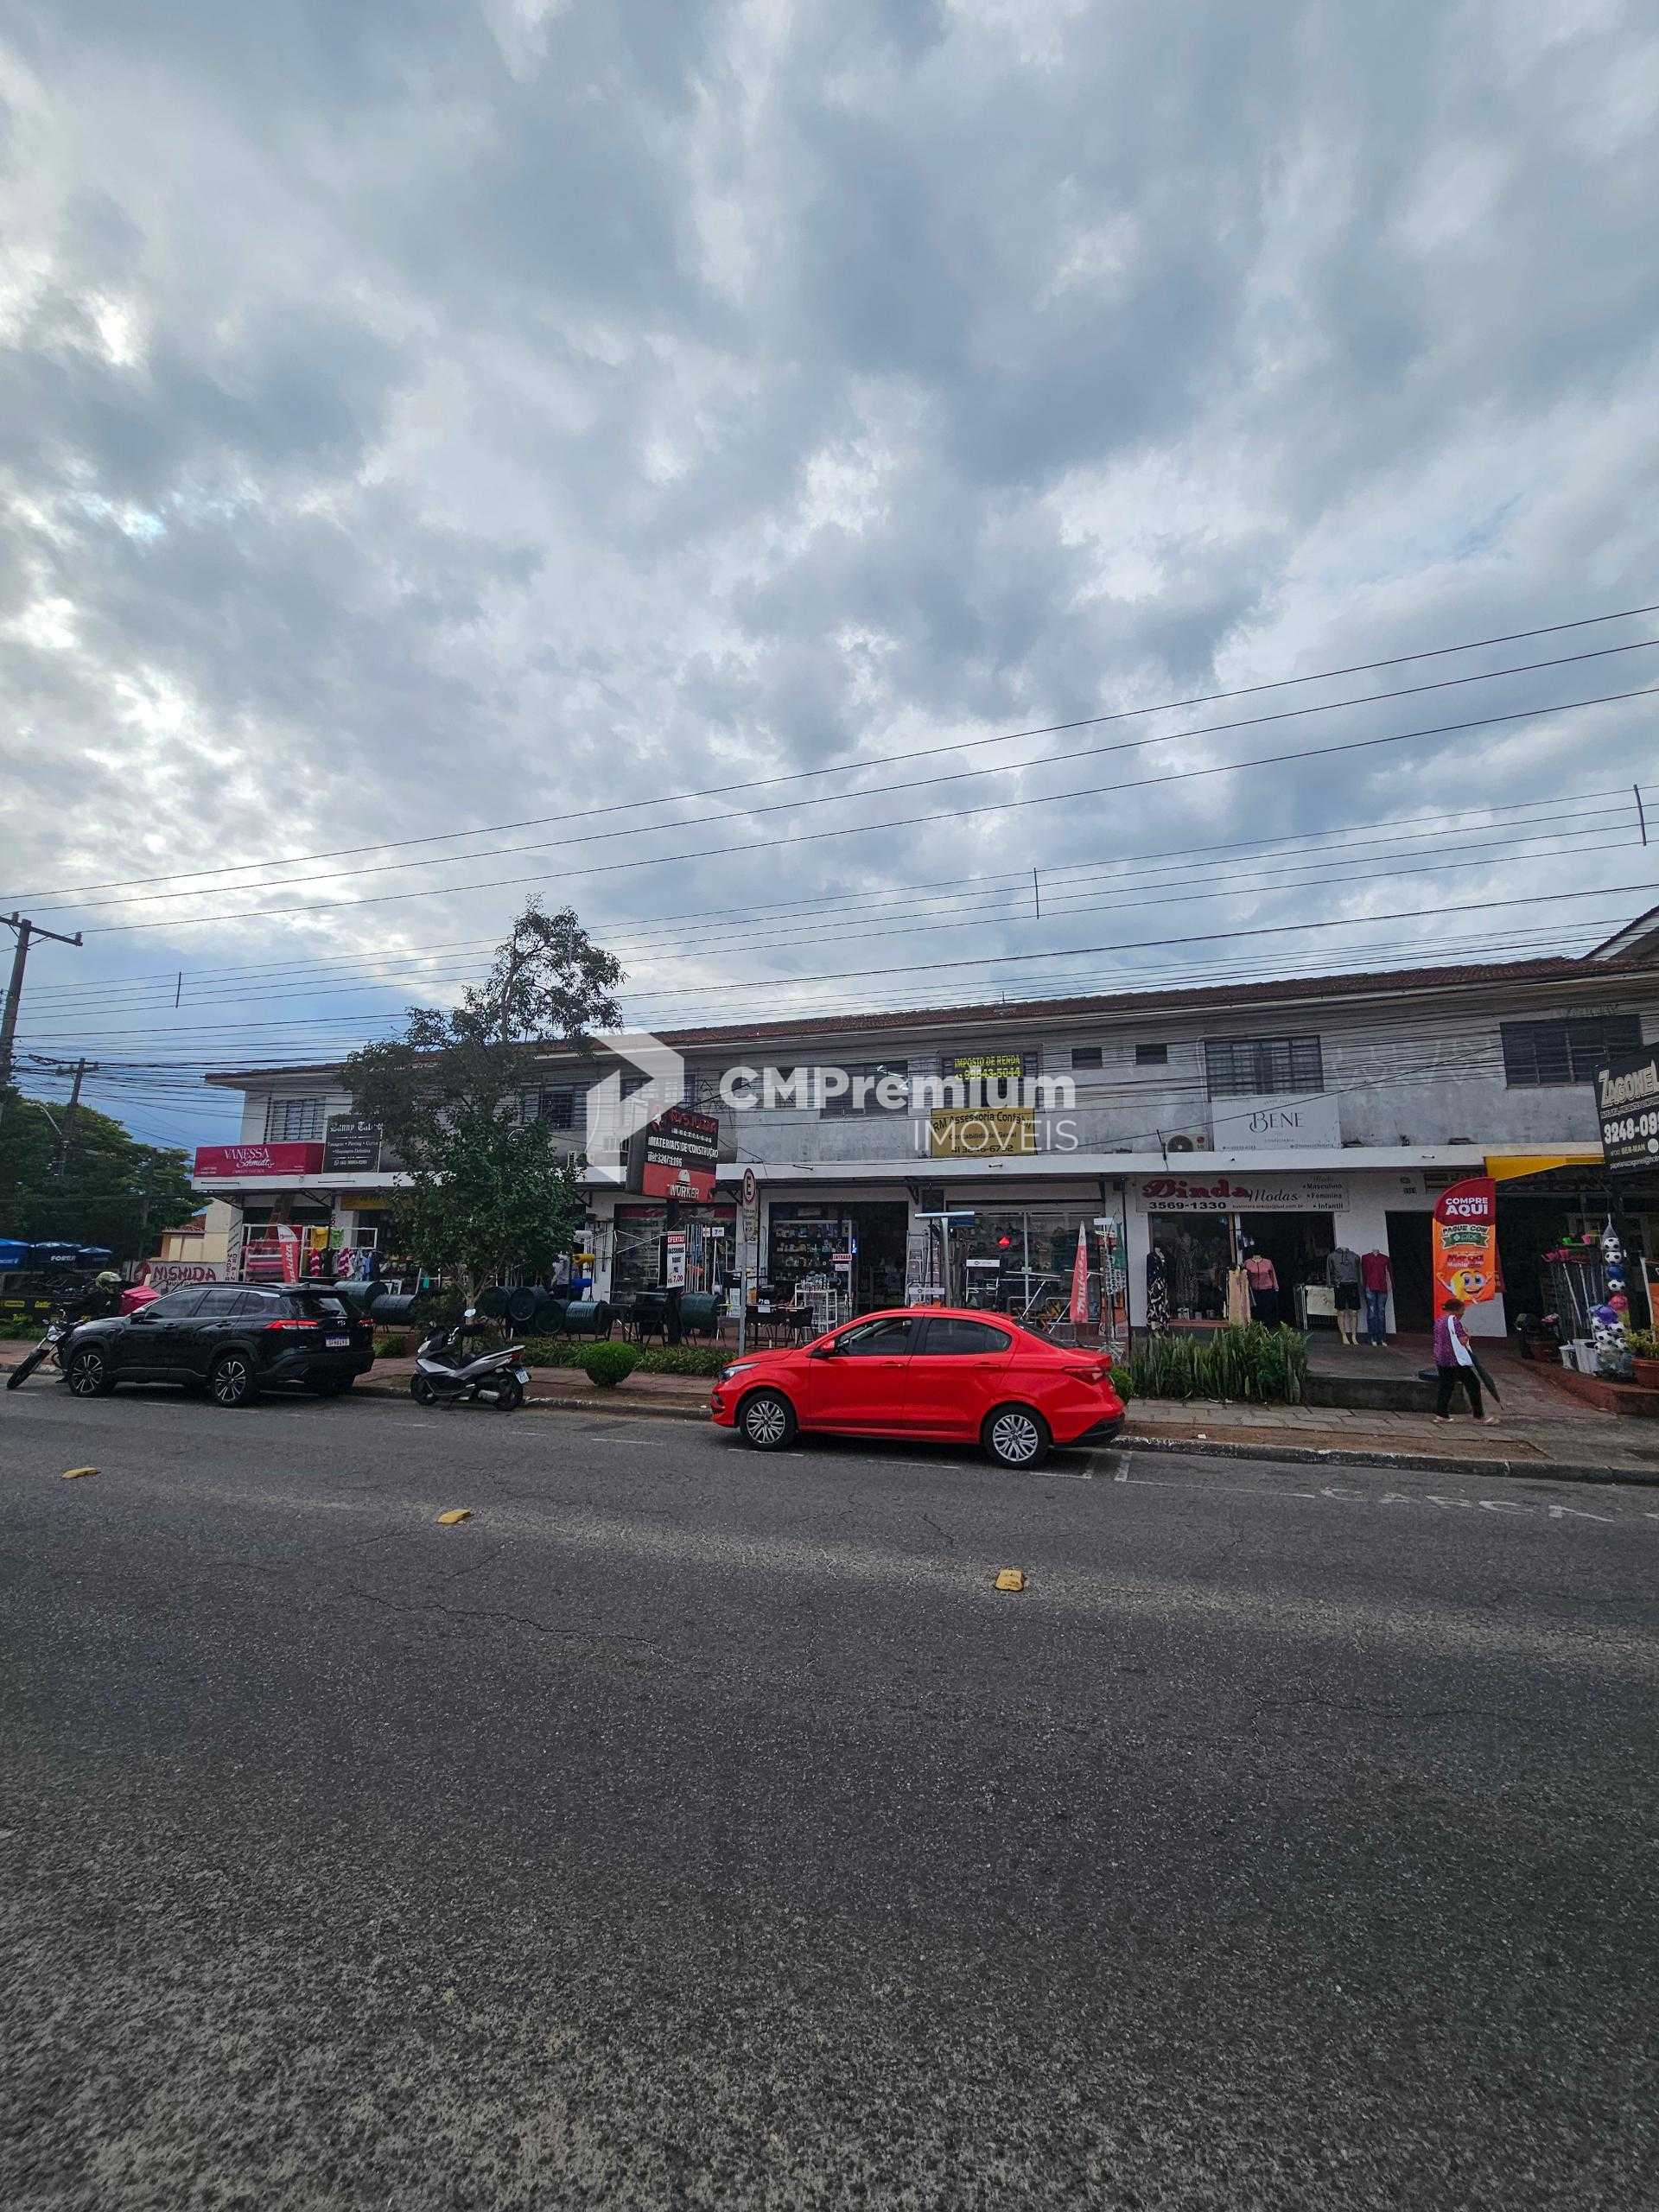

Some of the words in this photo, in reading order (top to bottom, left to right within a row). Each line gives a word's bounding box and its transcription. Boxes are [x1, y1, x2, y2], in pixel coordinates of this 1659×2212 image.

[1249, 1112, 1305, 1134] BENE
[1604, 1111, 1659, 1145] 3248-08
[223, 1147, 270, 1160] VANESSA
[670, 1184, 700, 1198] WORKER
[1141, 1179, 1248, 1199] Dinda
[1245, 1188, 1300, 1203] Modas
[1149, 1201, 1227, 1210] 3569-1330
[1445, 1204, 1488, 1217] AQUI
[1442, 1225, 1468, 1234] PAGUE
[153, 1266, 216, 1281] NISHIDA
